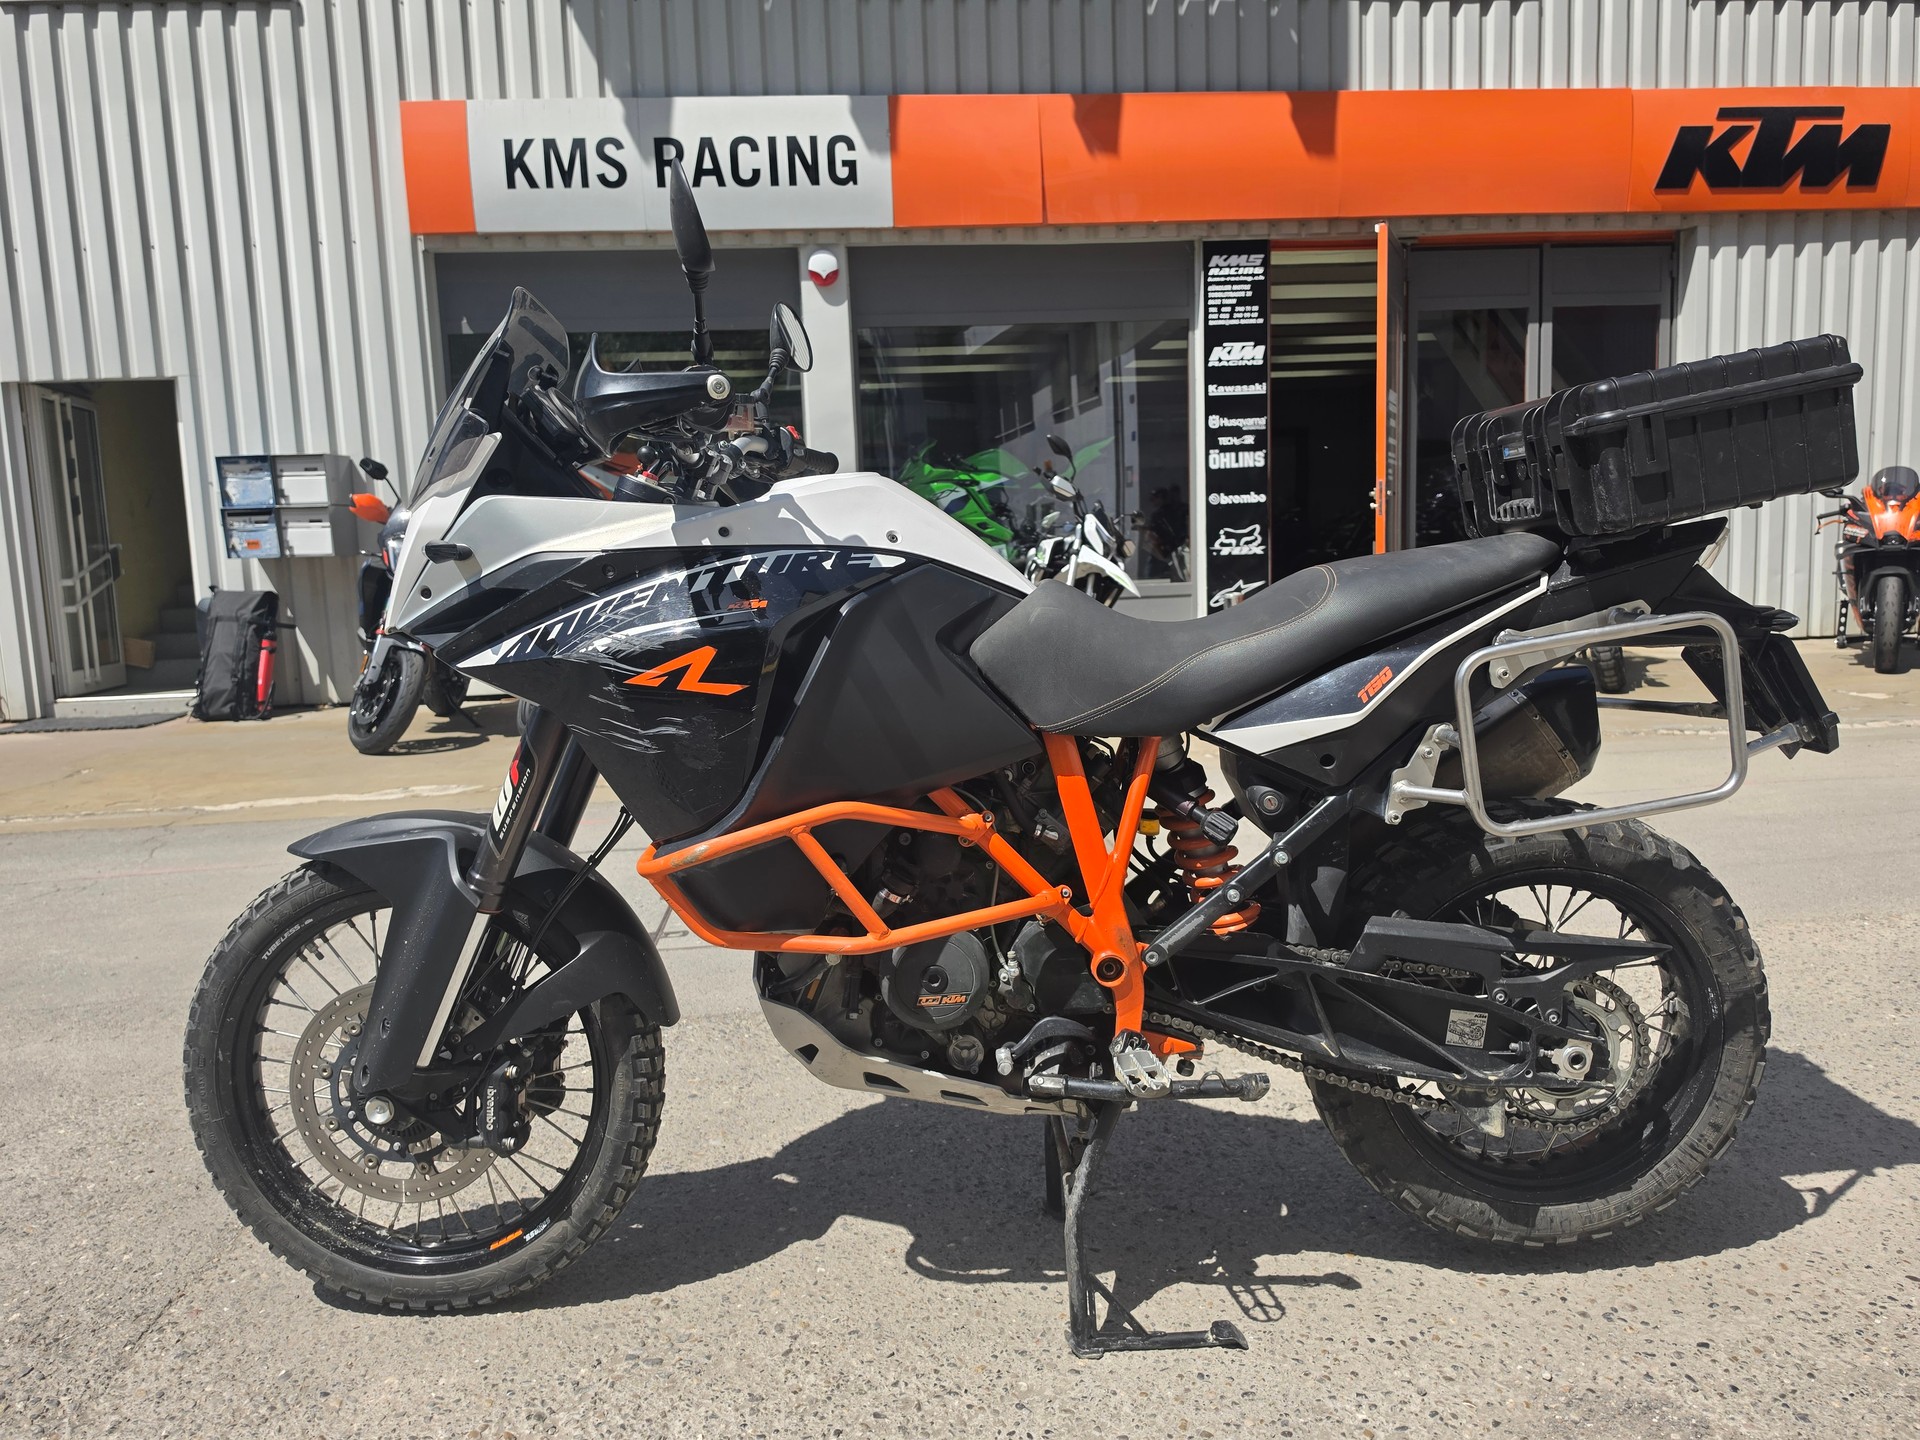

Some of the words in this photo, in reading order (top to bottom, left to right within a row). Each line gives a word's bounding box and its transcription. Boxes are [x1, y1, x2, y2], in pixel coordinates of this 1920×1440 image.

[1654, 106, 1891, 191] KTM
[503, 137, 628, 189] KMS
[654, 134, 859, 188] RACING
[1208, 254, 1265, 268] KMS
[1208, 341, 1266, 361] KTM
[1208, 359, 1263, 367] RACING
[1208, 382, 1267, 394] Kawasaki
[1209, 449, 1266, 469] ÖHLINS
[1220, 492, 1266, 505] brembo
[1357, 665, 1393, 704] 1190
[499, 768, 531, 840] SUSPENSION
[261, 923, 301, 960] TUBELESS
[942, 994, 967, 1004] KTM
[486, 1087, 497, 1131] brembo
